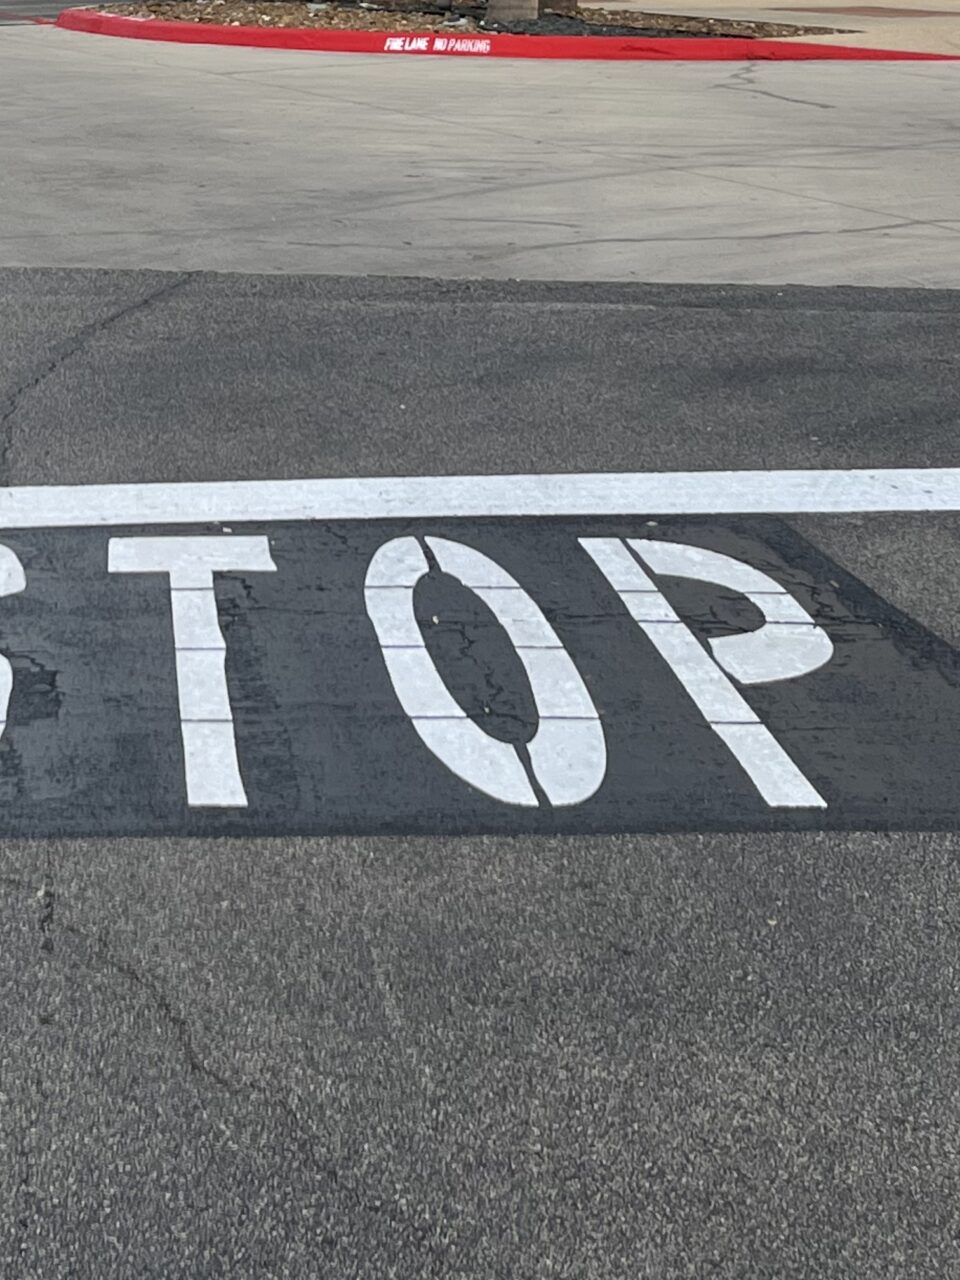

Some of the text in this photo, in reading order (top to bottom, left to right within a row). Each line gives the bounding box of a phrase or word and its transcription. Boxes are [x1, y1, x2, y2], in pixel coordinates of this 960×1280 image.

[405, 37, 428, 51] LANE
[433, 37, 448, 52] NO
[447, 38, 491, 54] PARKING
